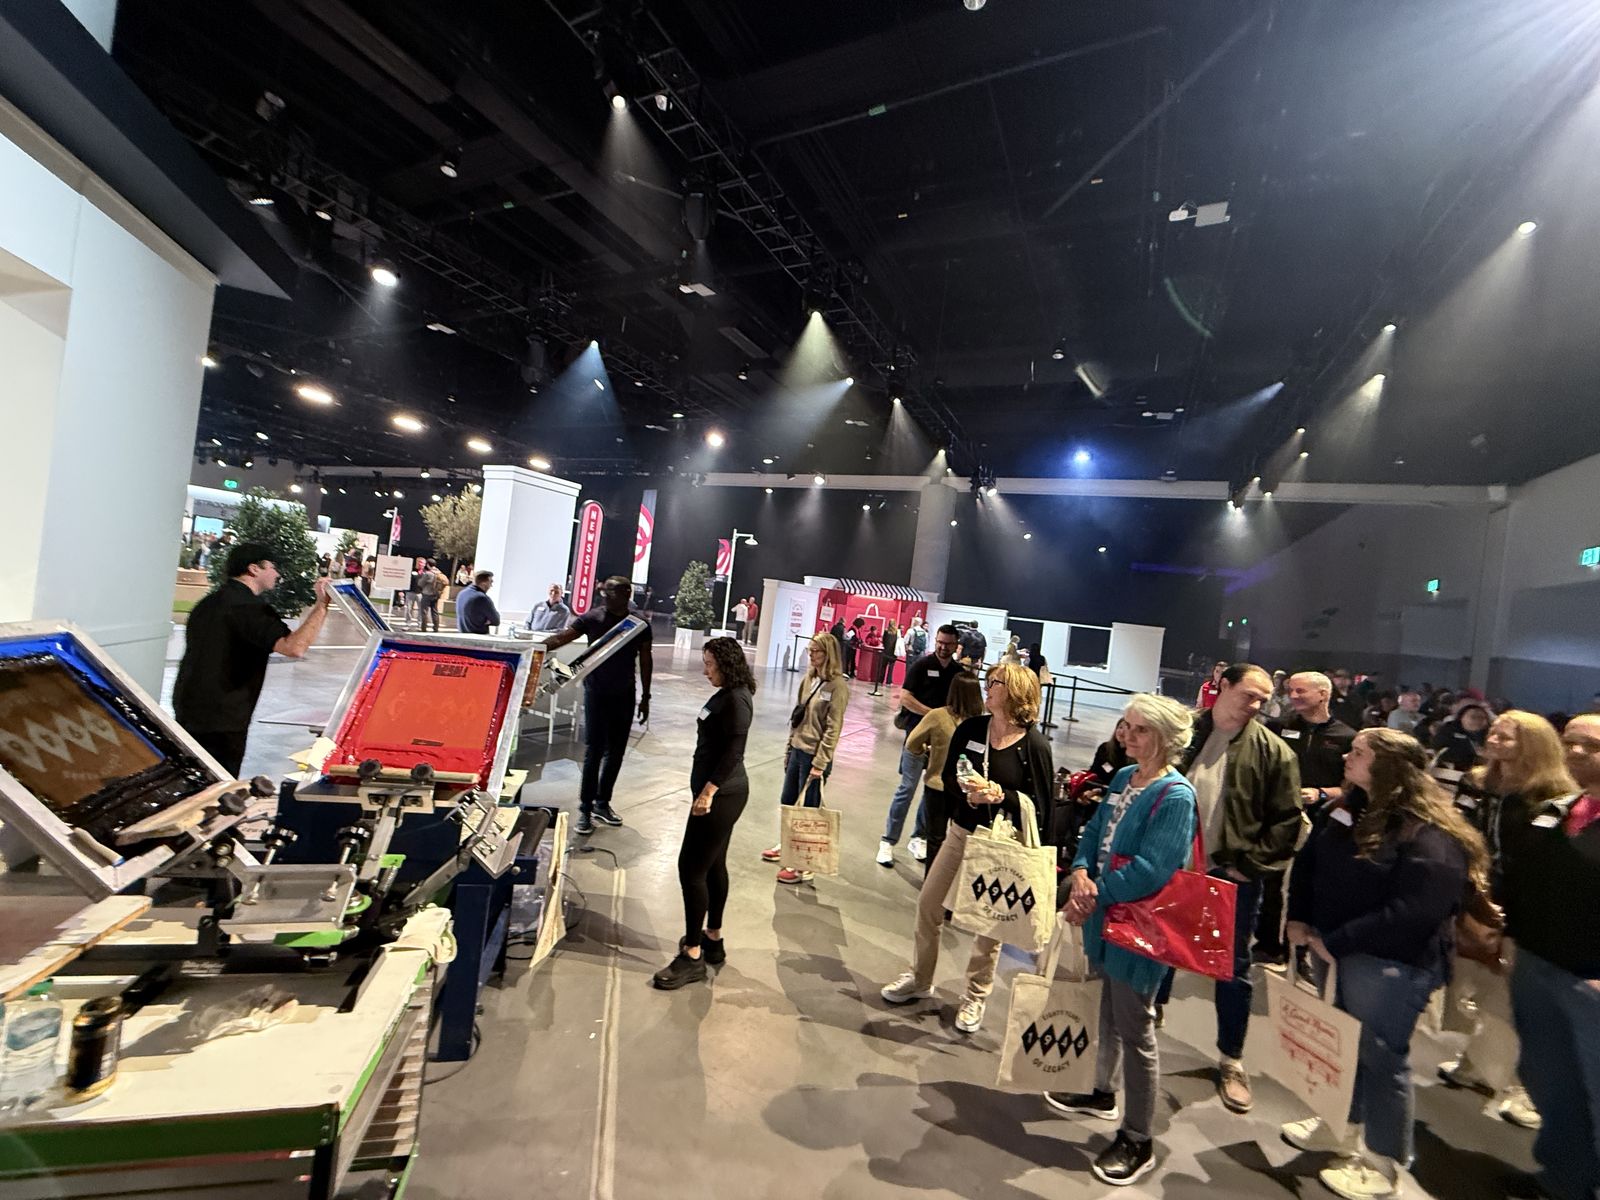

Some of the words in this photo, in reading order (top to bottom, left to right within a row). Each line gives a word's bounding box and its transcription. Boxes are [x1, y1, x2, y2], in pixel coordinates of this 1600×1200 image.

[579, 511, 597, 608] NEWSSTAND
[988, 866, 1008, 875] EIGHTY
[1010, 868, 1025, 882] YEARS
[982, 905, 992, 914] OF
[993, 912, 1018, 921] LEGACY
[1042, 1009, 1064, 1021] EIGHTY
[1065, 1009, 1080, 1023] YEARS
[1032, 1058, 1043, 1068] OF
[1043, 1061, 1070, 1073] LEGACY
